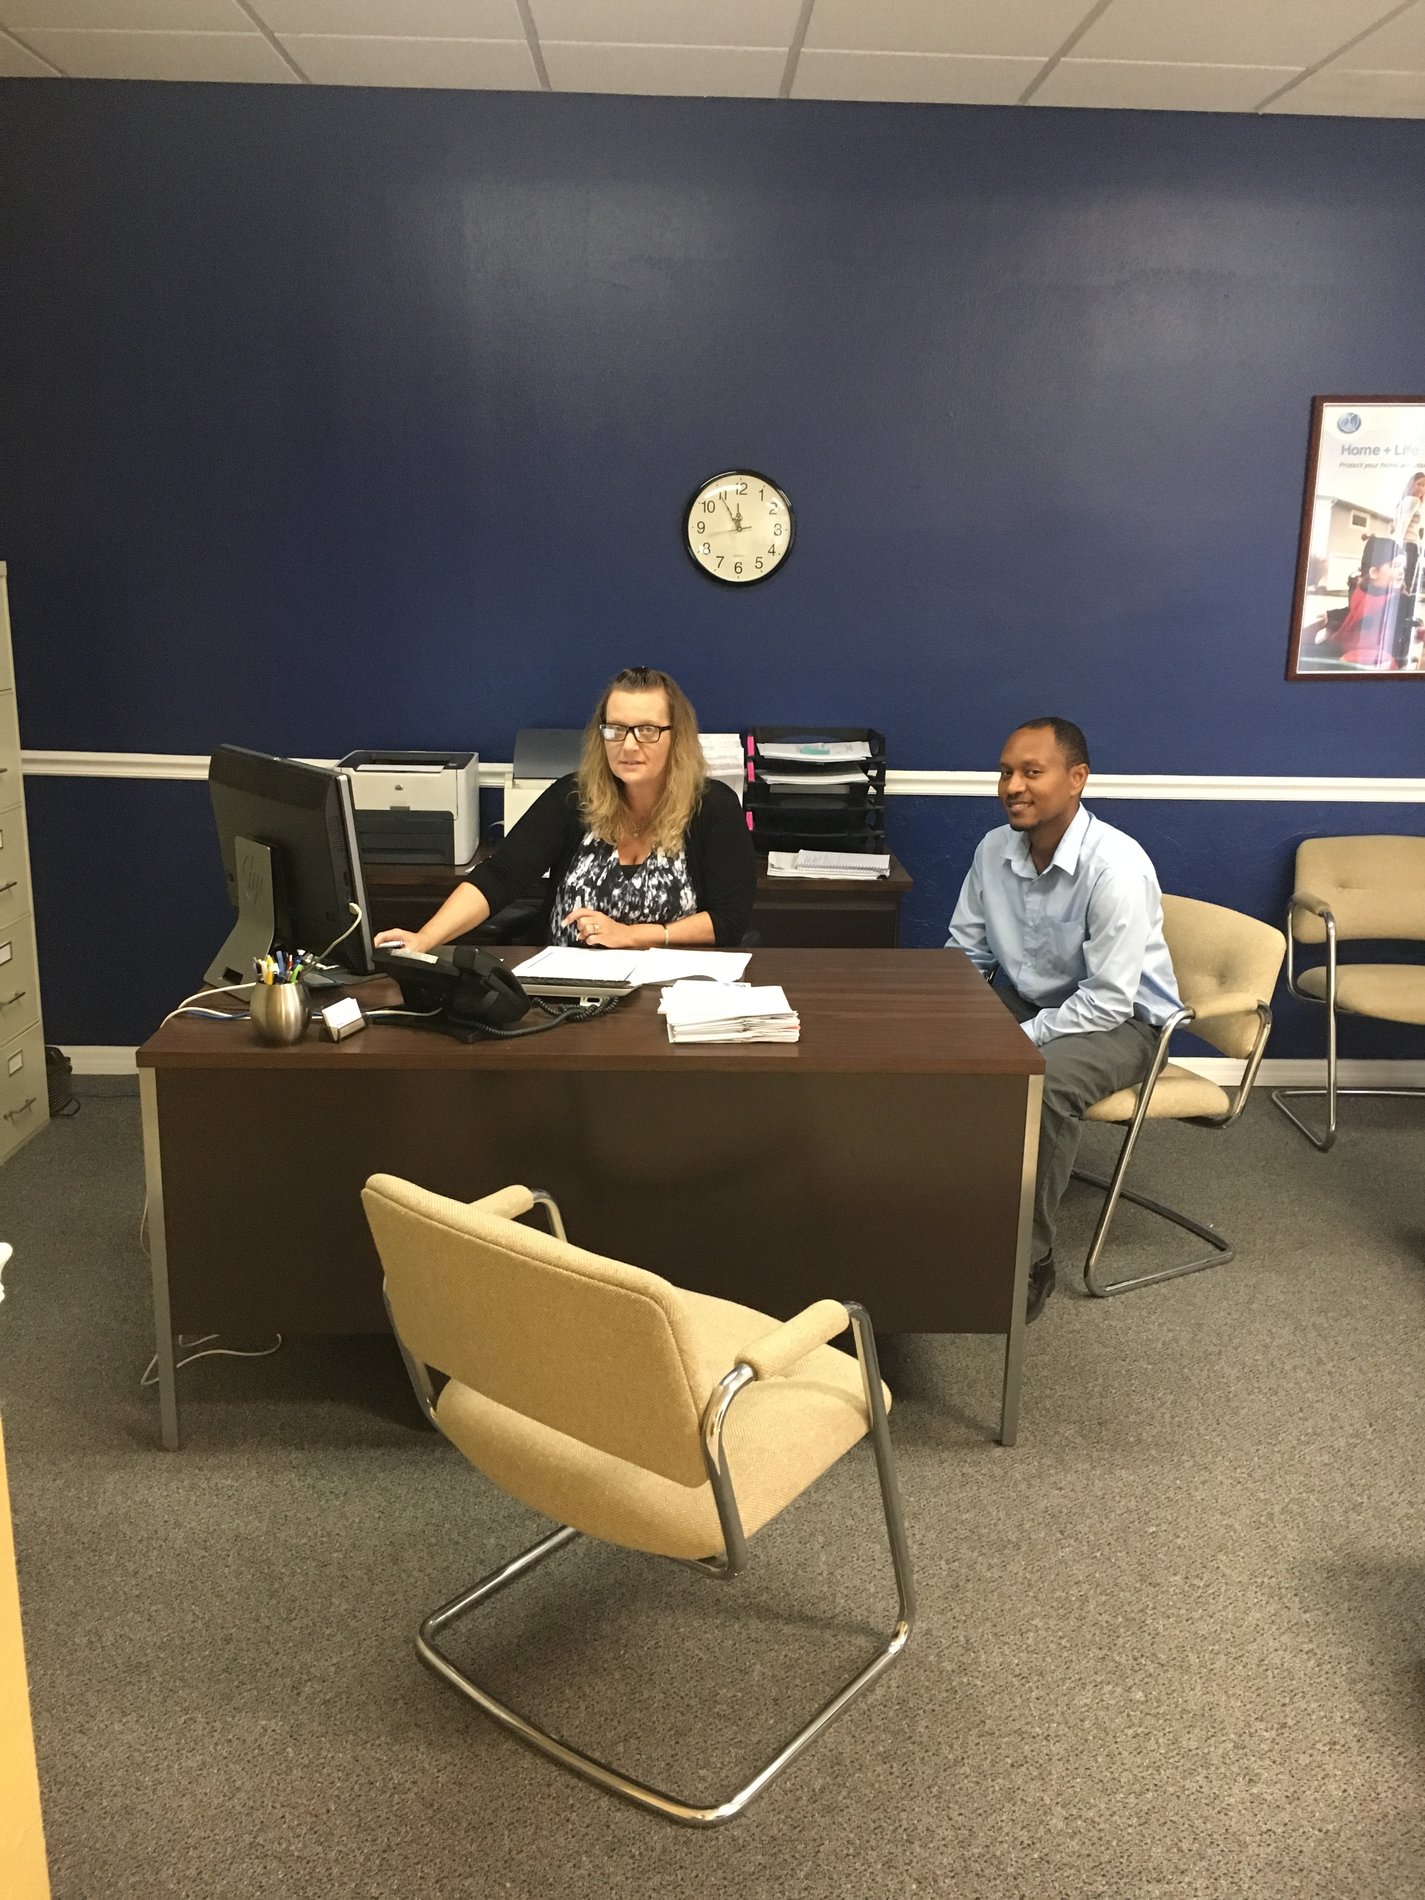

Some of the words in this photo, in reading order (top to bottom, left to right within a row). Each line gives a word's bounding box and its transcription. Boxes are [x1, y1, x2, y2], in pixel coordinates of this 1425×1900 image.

[1341, 444, 1381, 456] Home
[1394, 444, 1420, 456] Life
[736, 482, 748, 496] 12
[758, 488, 764, 502] 1
[701, 500, 716, 513] 10
[769, 501, 778, 515] 2
[696, 521, 706, 534] 9
[773, 523, 782, 536] 3
[767, 543, 776, 556] 4
[716, 555, 725, 568] 7
[734, 561, 743, 574] 6
[755, 556, 763, 569] 5
